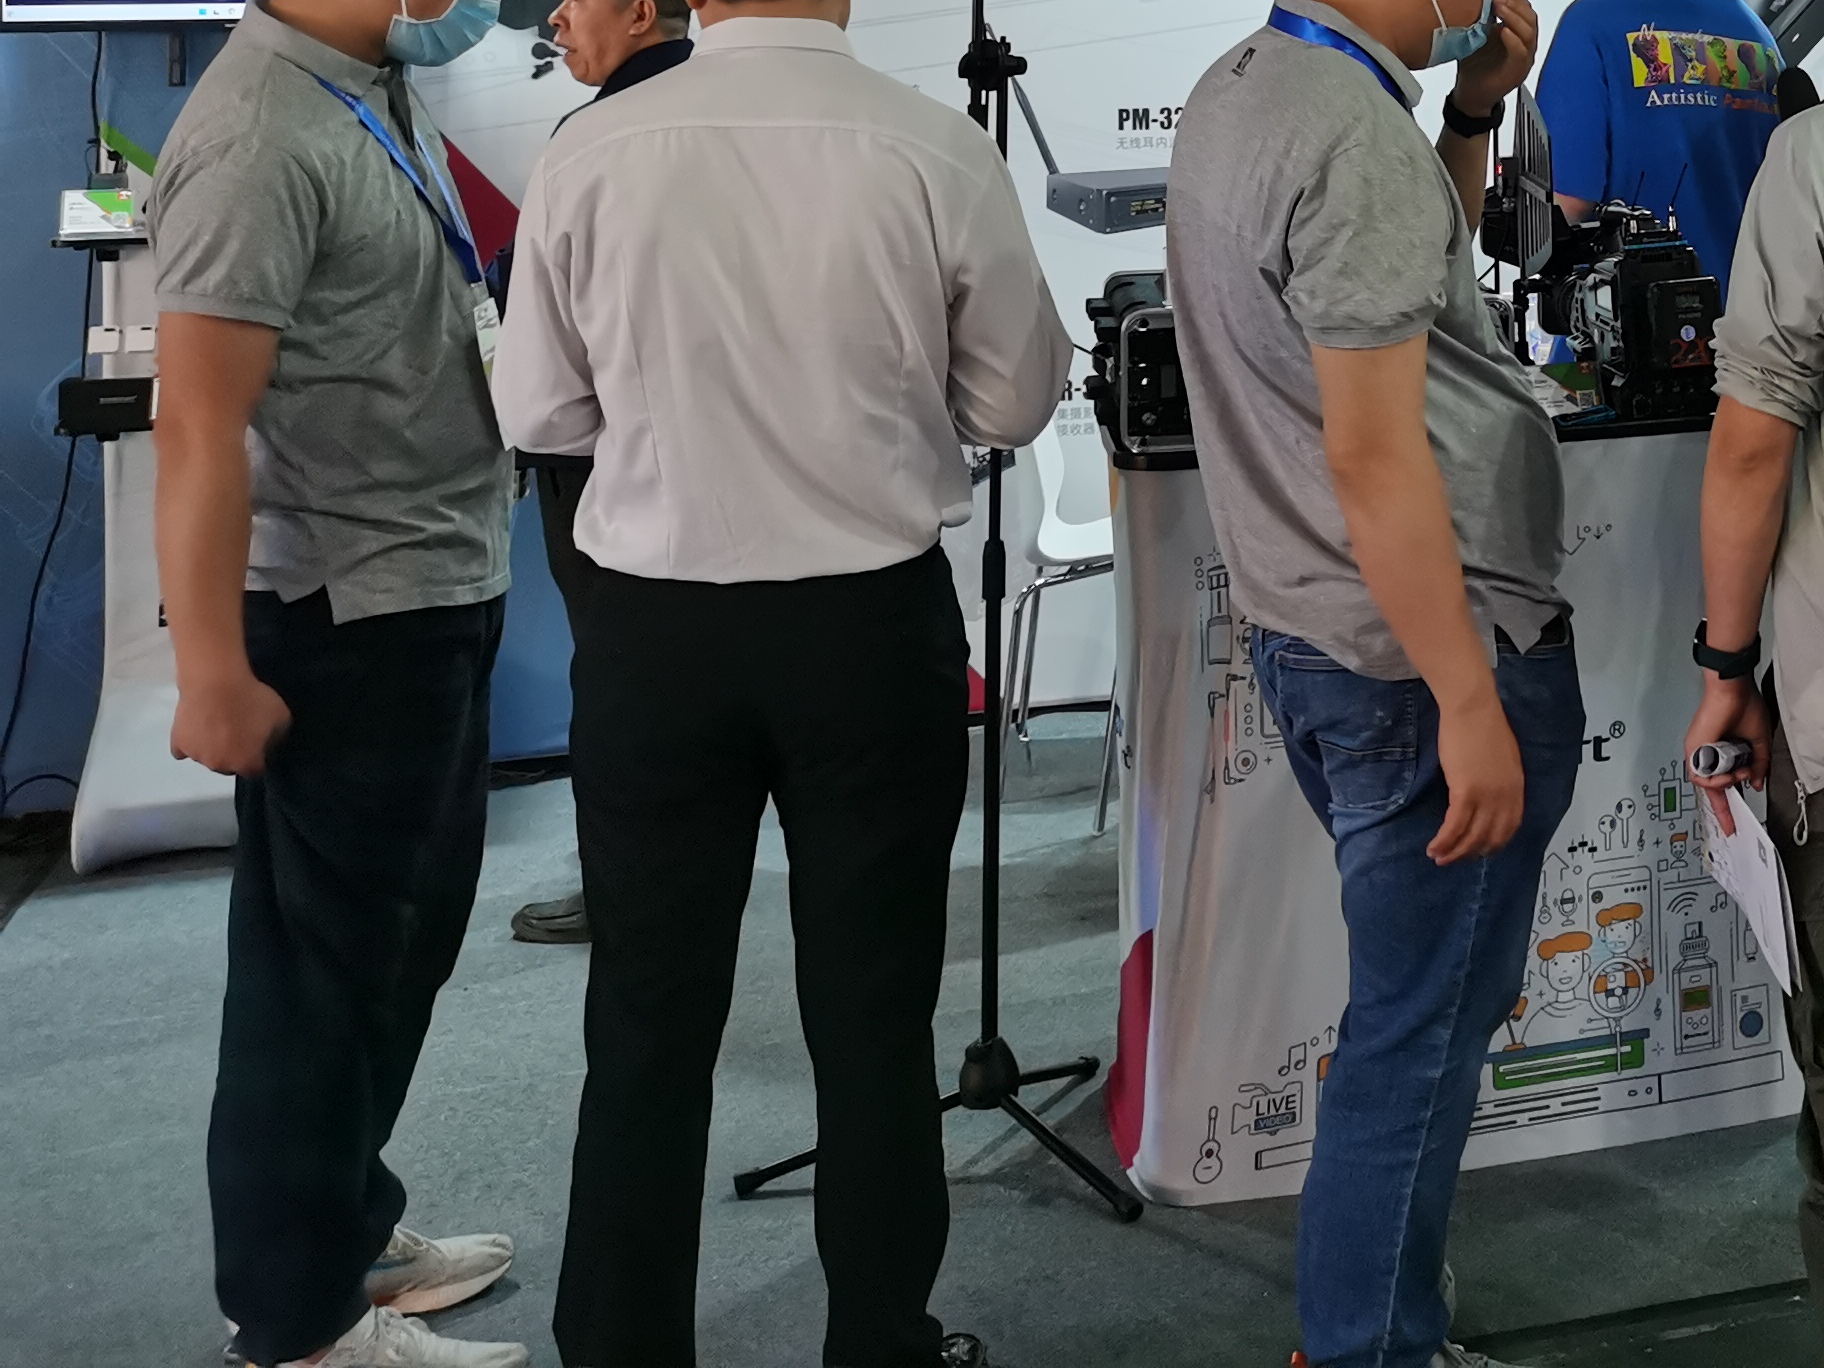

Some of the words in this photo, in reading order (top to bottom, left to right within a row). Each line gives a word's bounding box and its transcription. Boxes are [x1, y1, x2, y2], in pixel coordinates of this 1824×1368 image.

[1645, 88, 1718, 107] Artistic
[1255, 1093, 1297, 1117] LIVE
[1258, 1113, 1292, 1128] VIDEO
